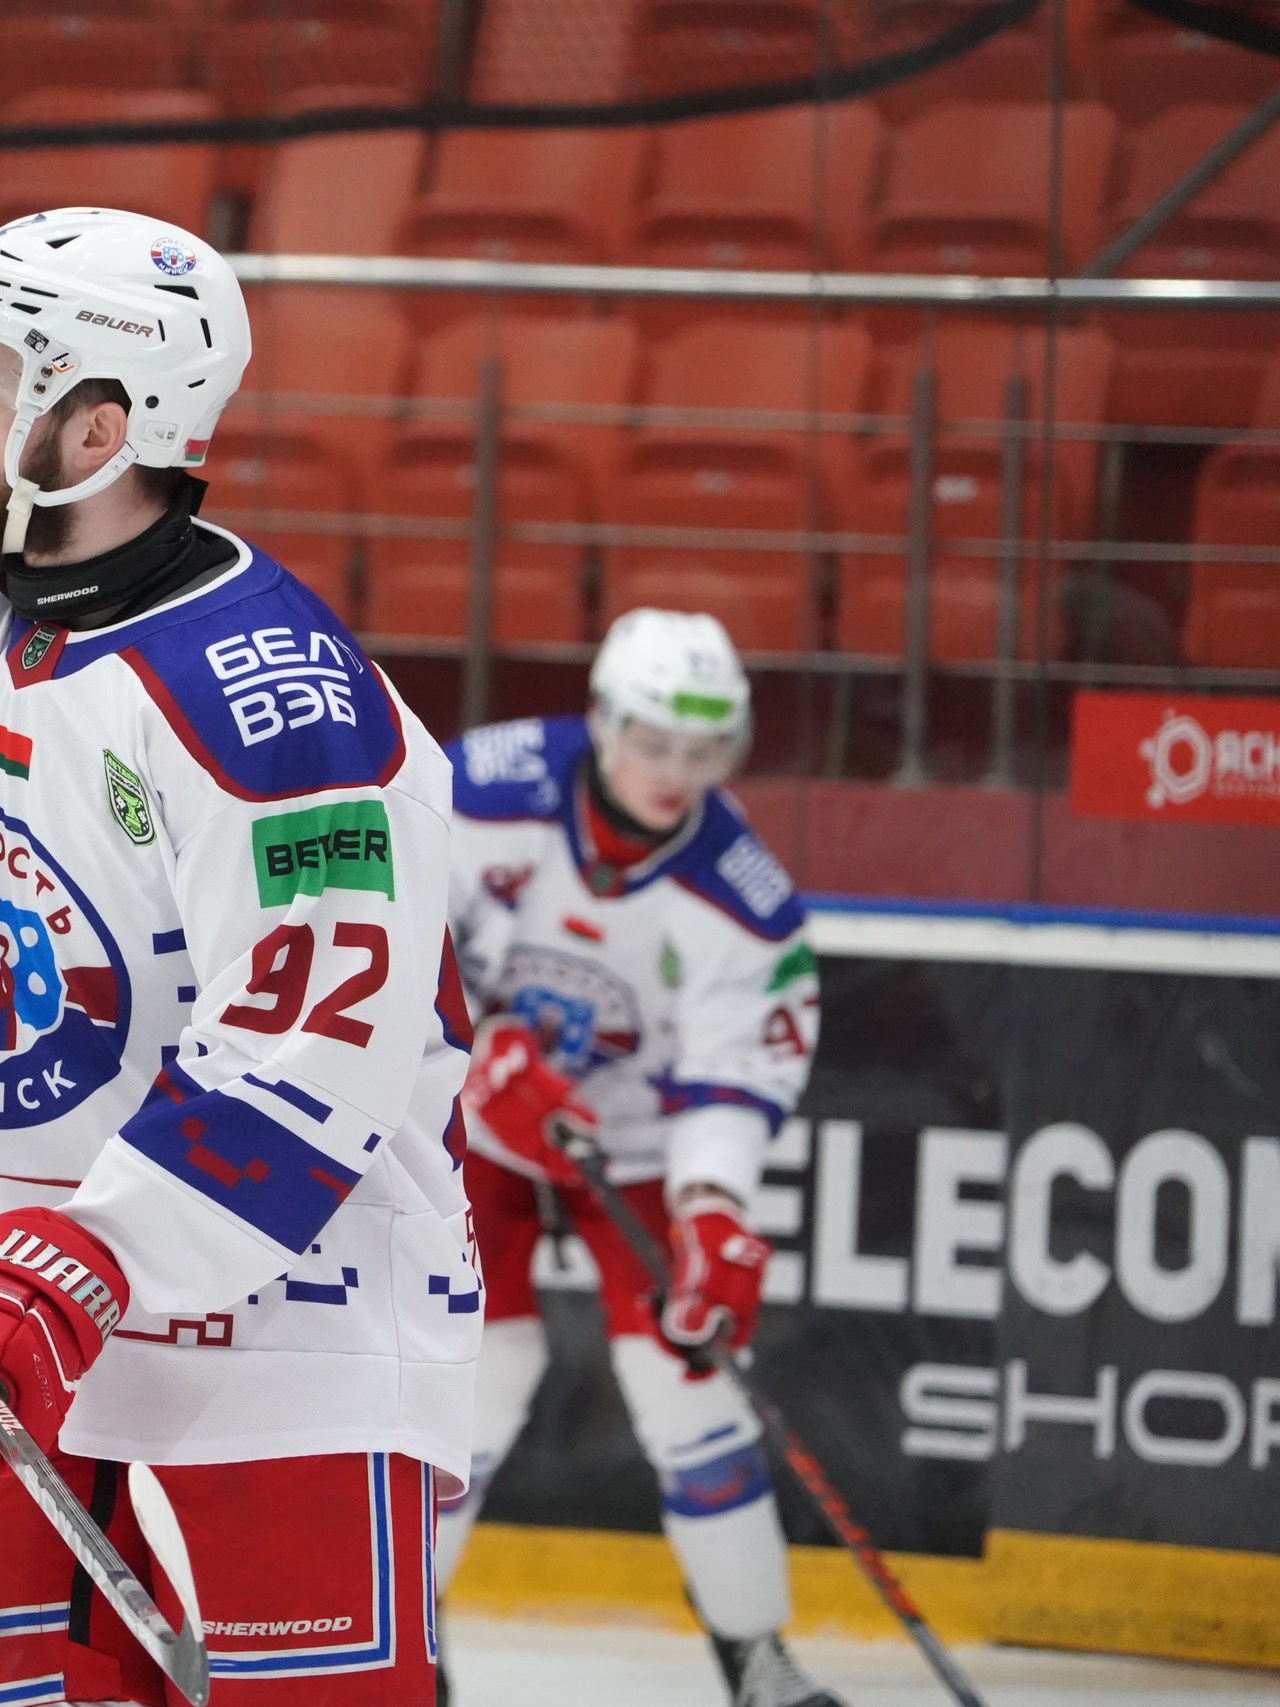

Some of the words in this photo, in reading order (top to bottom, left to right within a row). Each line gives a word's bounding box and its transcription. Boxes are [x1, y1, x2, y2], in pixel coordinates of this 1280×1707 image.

[75, 310, 154, 338] BAUER
[37, 585, 99, 605] SHERWOOD
[205, 627, 345, 680] БЕЛ
[229, 681, 357, 748] ВЭБ
[218, 921, 389, 1049] 92
[201, 1616, 353, 1637] SHERWOOD
